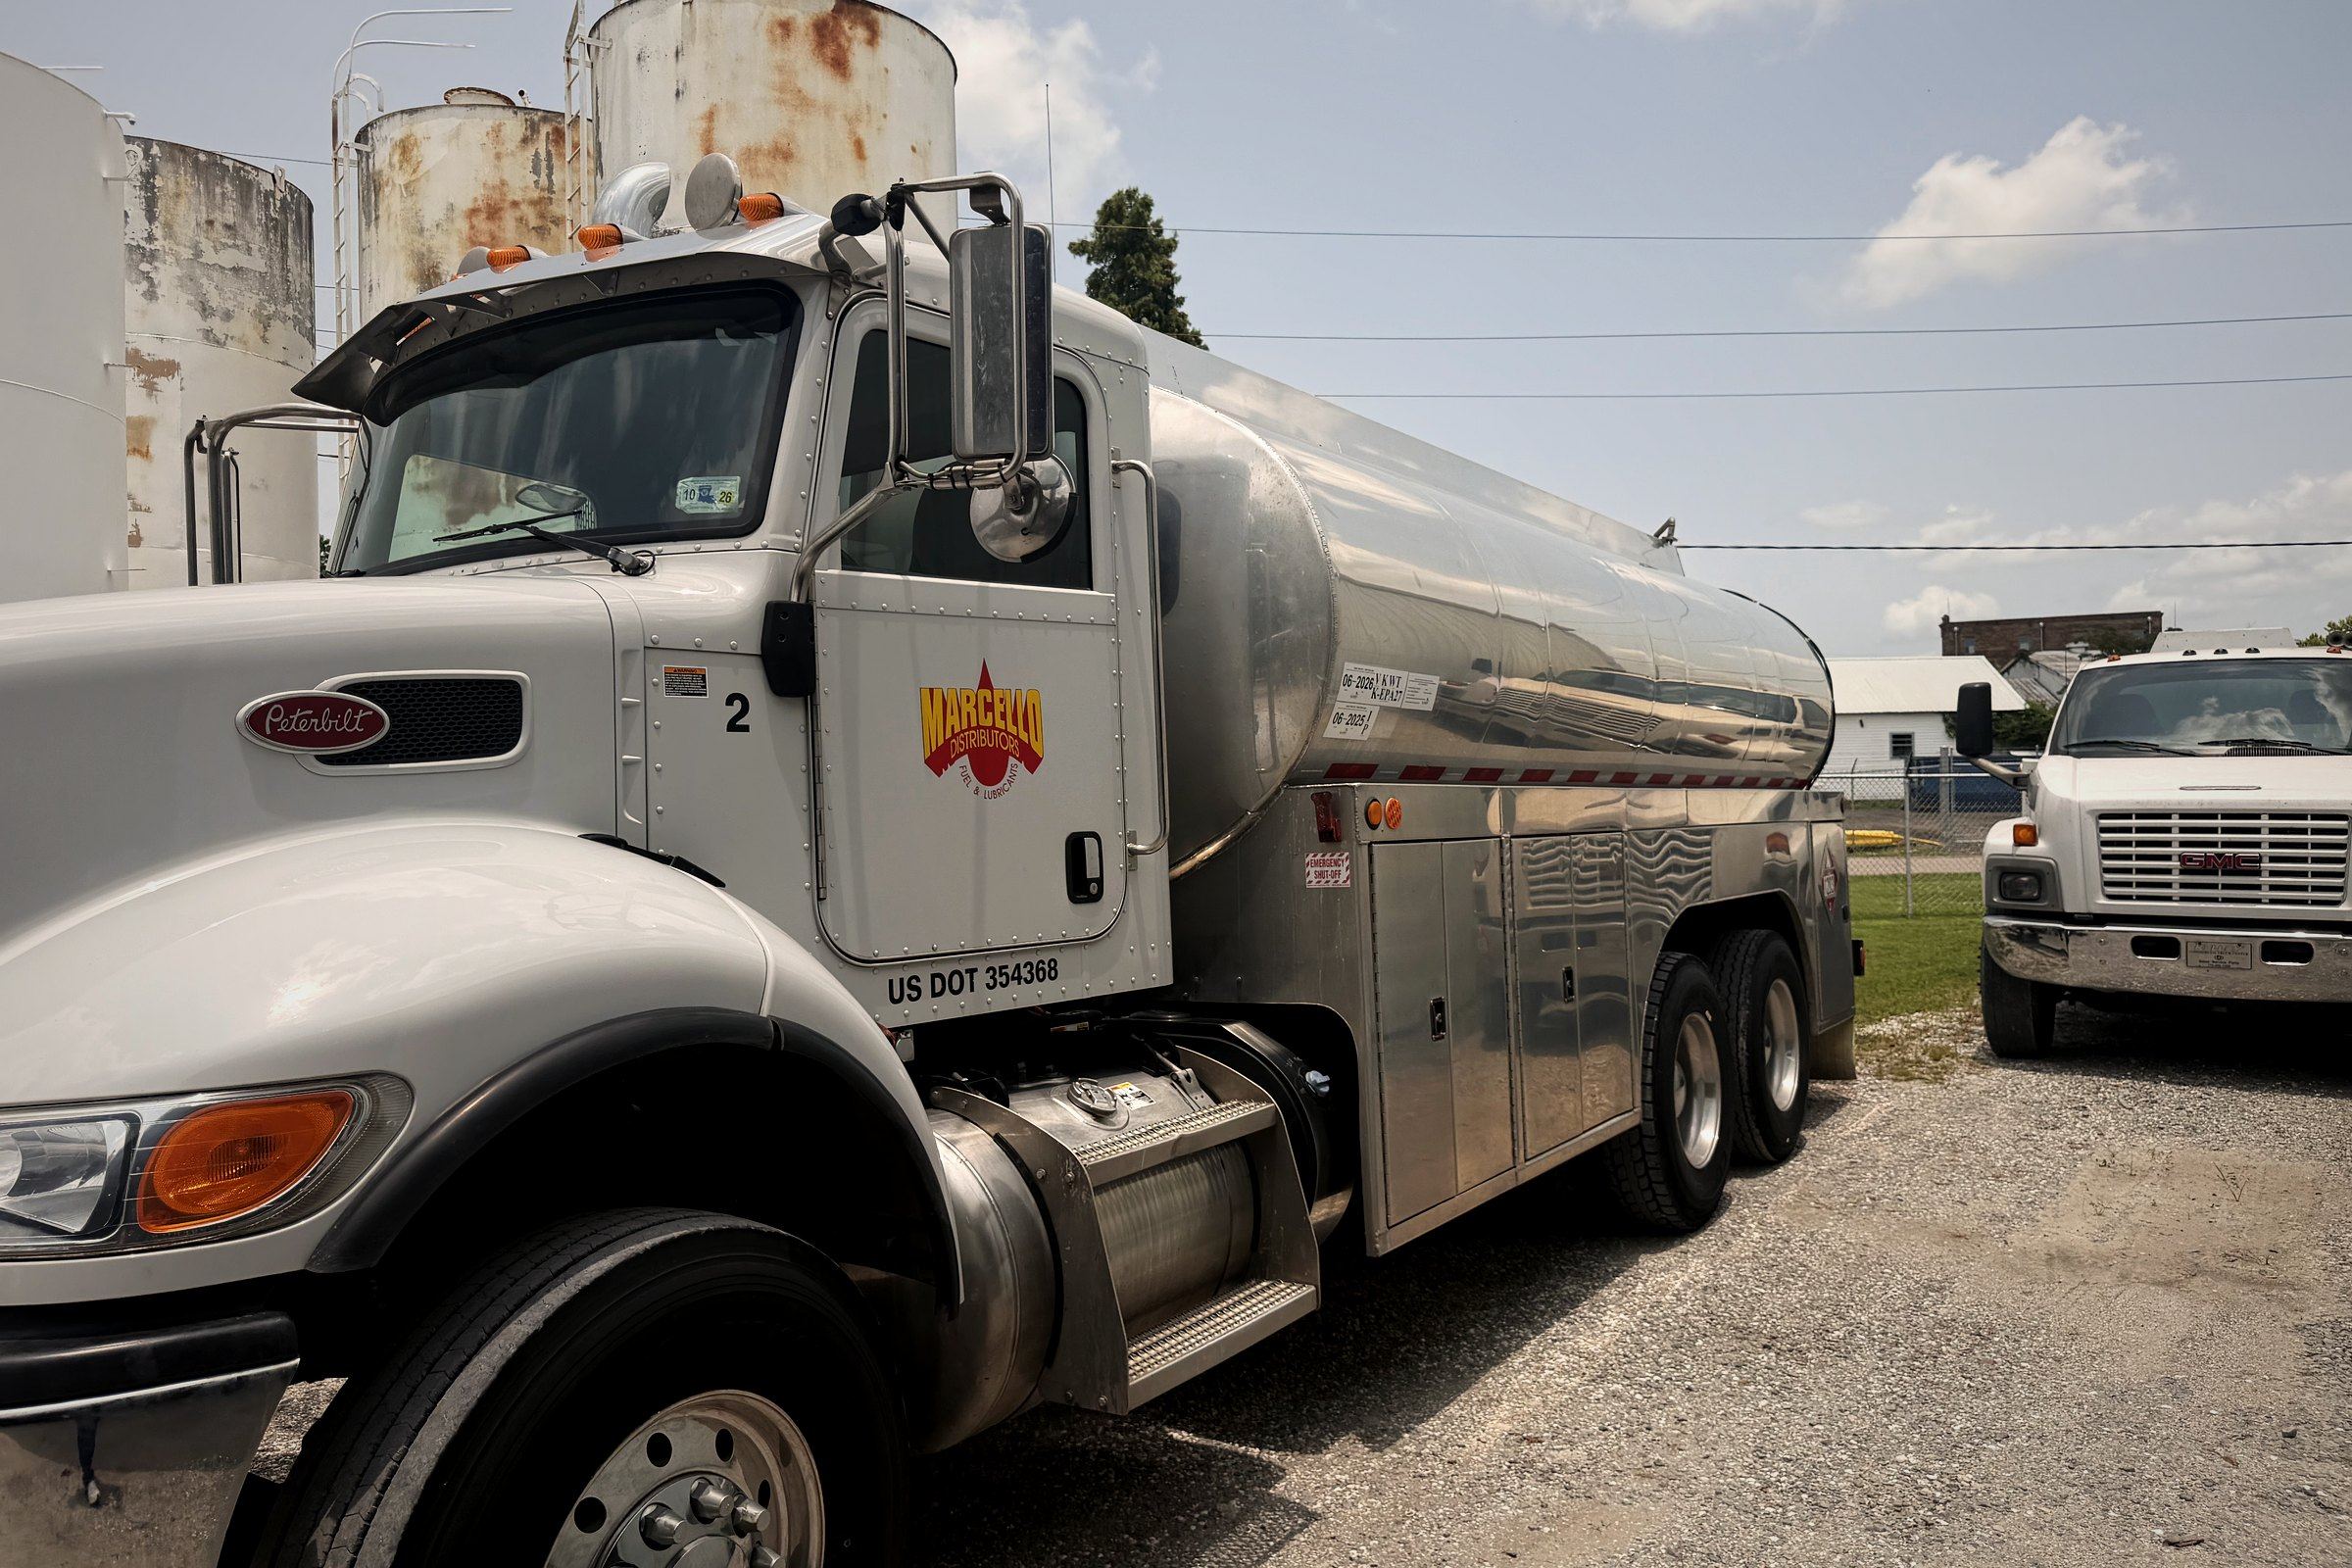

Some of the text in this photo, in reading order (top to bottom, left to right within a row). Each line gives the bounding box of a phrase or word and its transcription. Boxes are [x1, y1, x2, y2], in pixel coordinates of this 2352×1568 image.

[684, 489, 733, 504] 10 26
[1343, 674, 1374, 689] 06-2026
[265, 704, 373, 735] Peterbilt
[725, 692, 750, 732] 2
[920, 687, 1044, 761] MARCELLO
[1333, 712, 1365, 726] 06-2025
[950, 728, 1020, 759] DISTRIBUTORS
[958, 762, 1018, 800] FUEL & LUBRICANTS
[1310, 858, 1345, 867] EMERGENCY
[2180, 852, 2261, 869] GMC
[1314, 870, 1342, 879] SHUT-OFF
[888, 957, 1058, 1004] US DOT 354368
